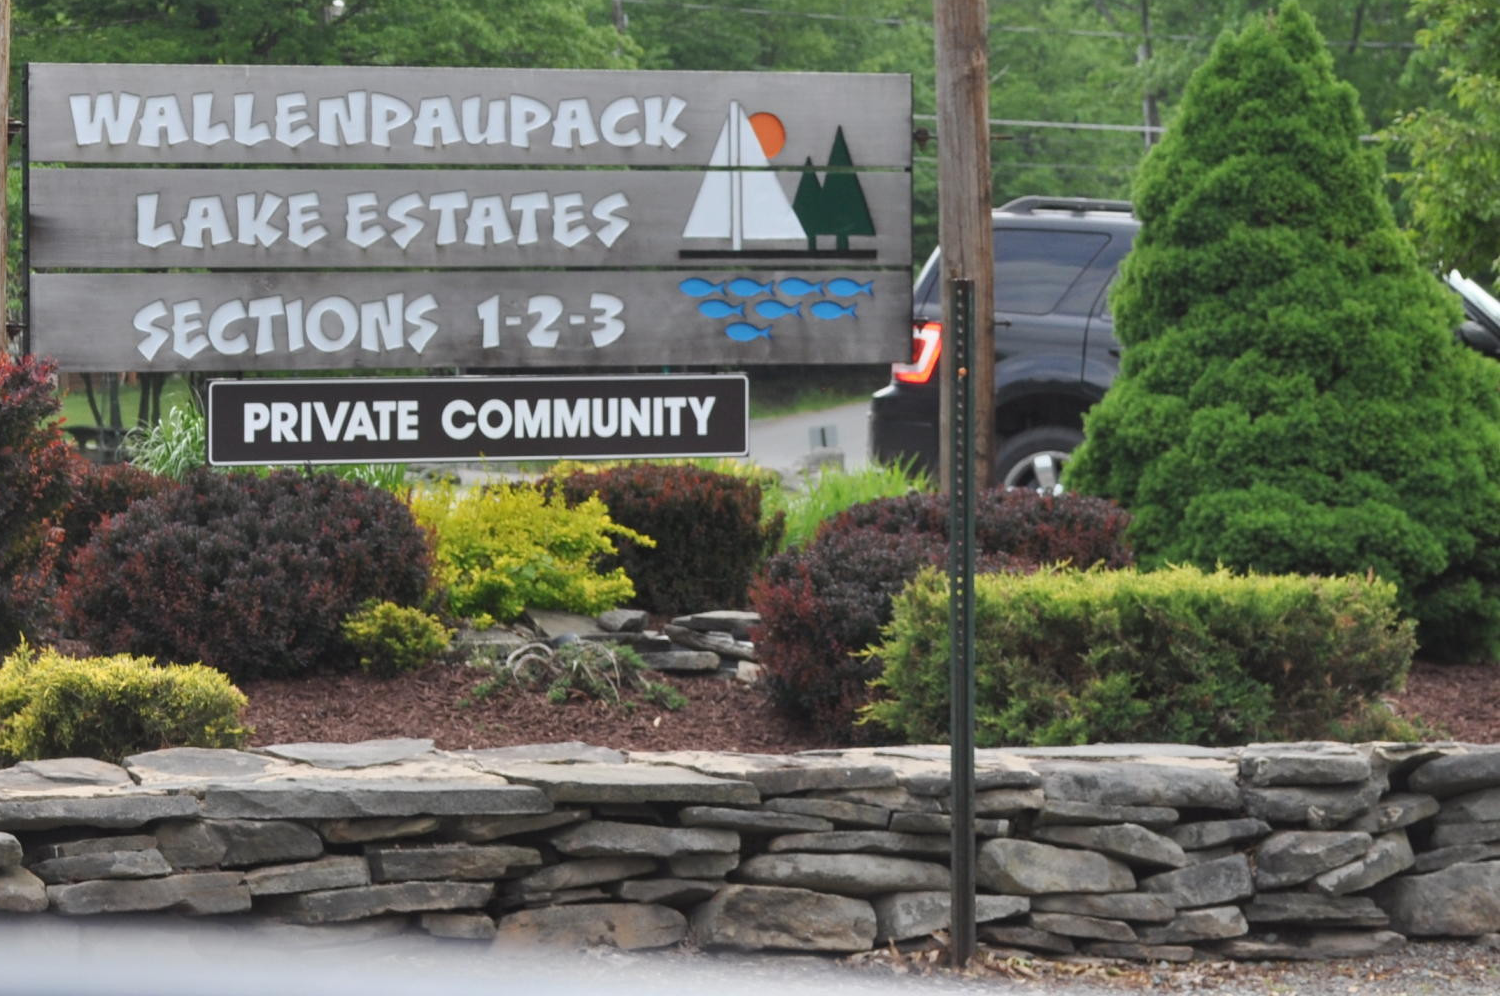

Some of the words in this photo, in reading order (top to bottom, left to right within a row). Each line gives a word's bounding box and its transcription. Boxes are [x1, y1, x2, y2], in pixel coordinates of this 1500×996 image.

[69, 92, 687, 149] WALLENPAUPACK
[137, 193, 326, 248] LAKE
[346, 193, 629, 249] ESTATES
[133, 295, 438, 360] SECTIONS
[477, 295, 624, 348] 1-2-3
[244, 401, 418, 443] PRIVATE
[441, 397, 715, 440] COMMUNITY
